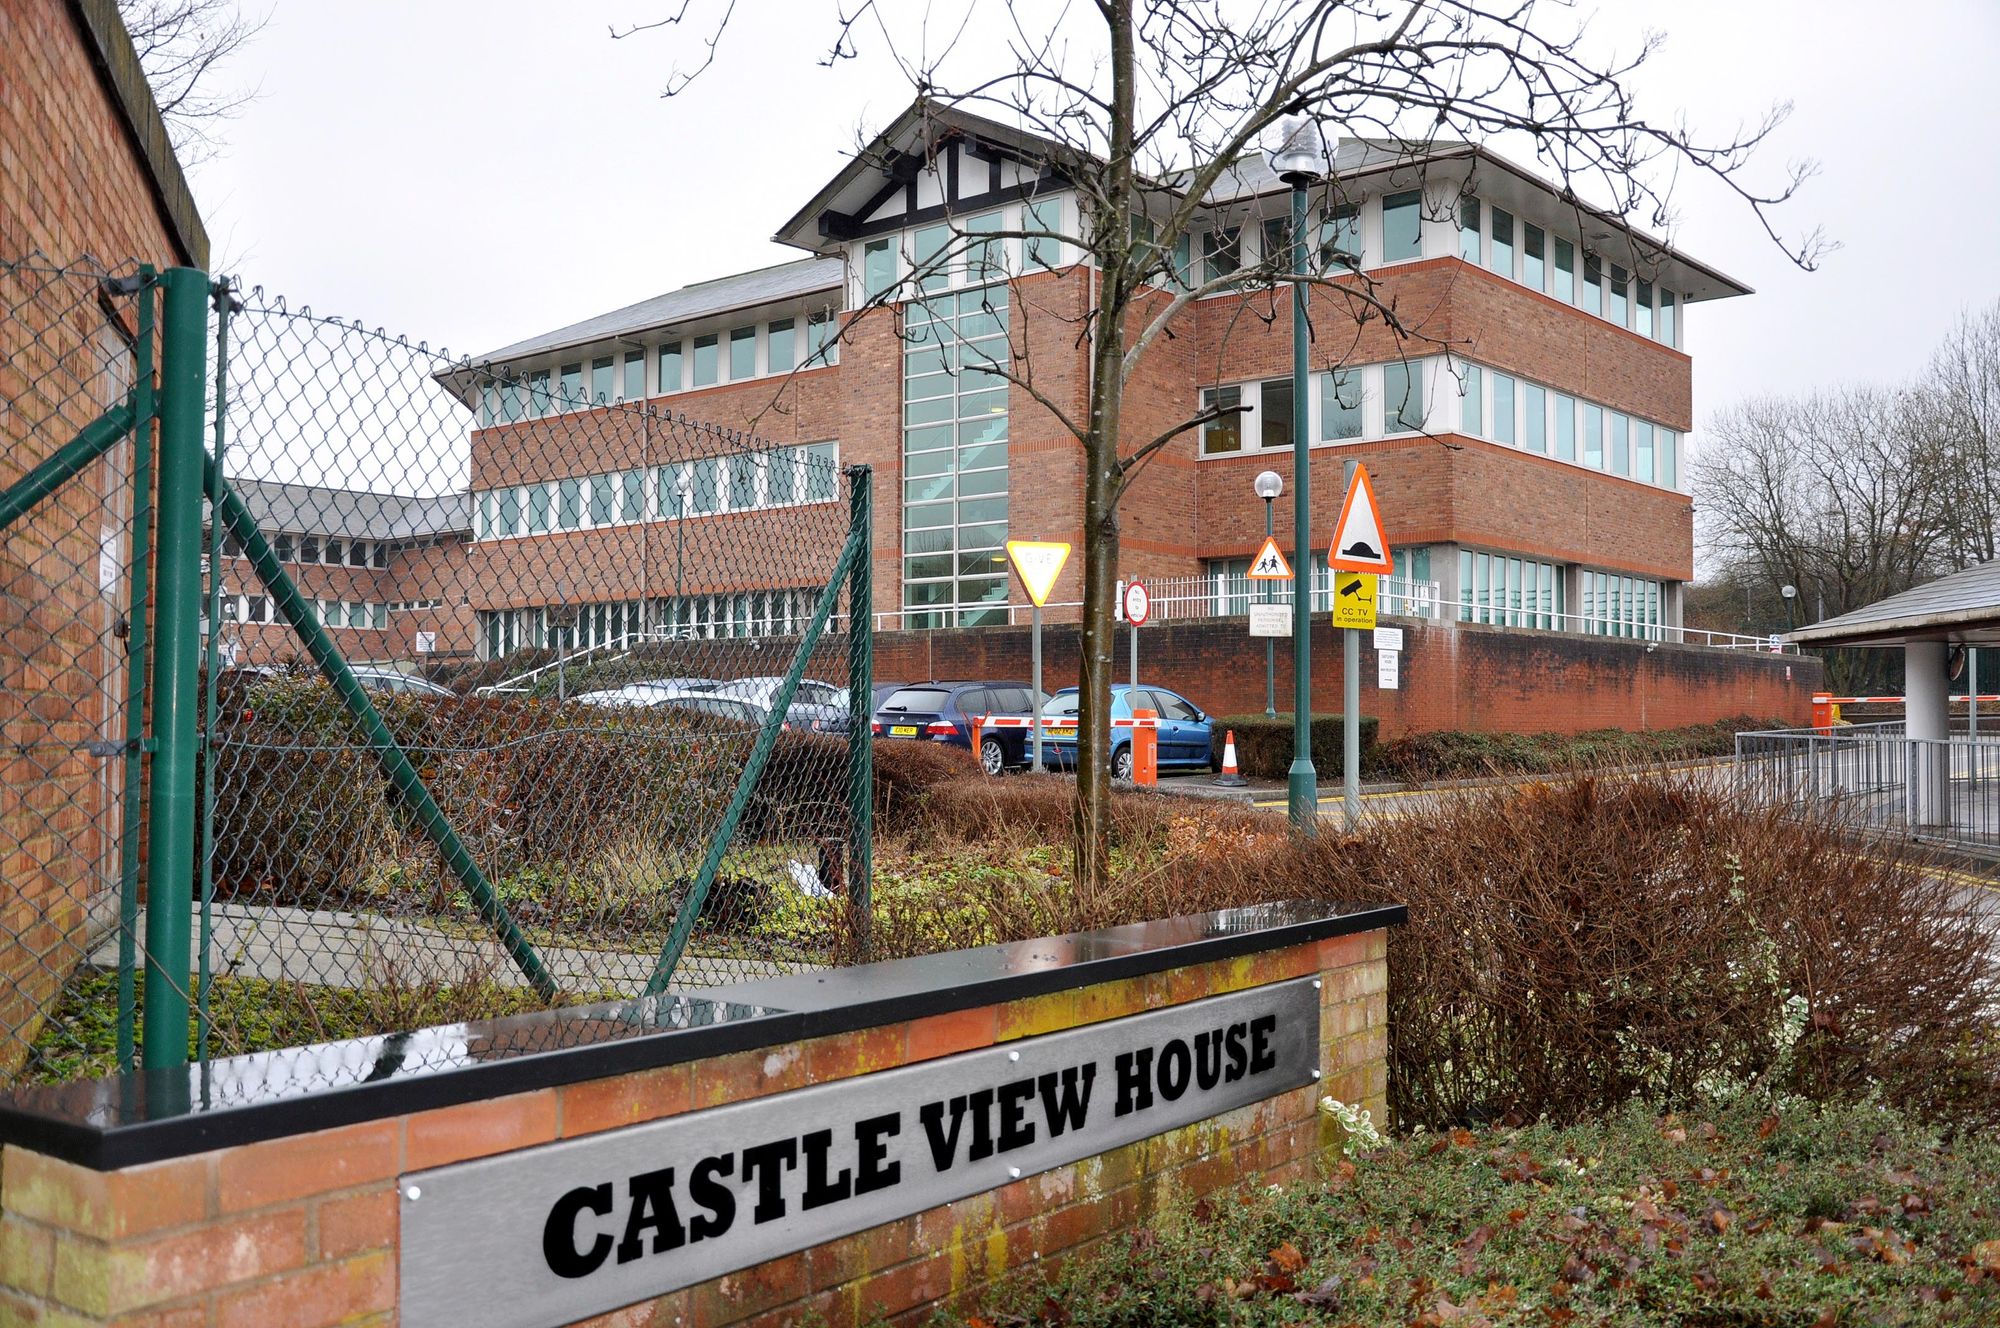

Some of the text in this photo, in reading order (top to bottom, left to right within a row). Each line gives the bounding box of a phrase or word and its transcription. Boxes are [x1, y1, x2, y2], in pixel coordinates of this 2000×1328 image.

[1341, 607, 1368, 616] CC TV
[1344, 616, 1373, 624] operation
[543, 1014, 1276, 1279] CASTLE VIEW HOUSE
